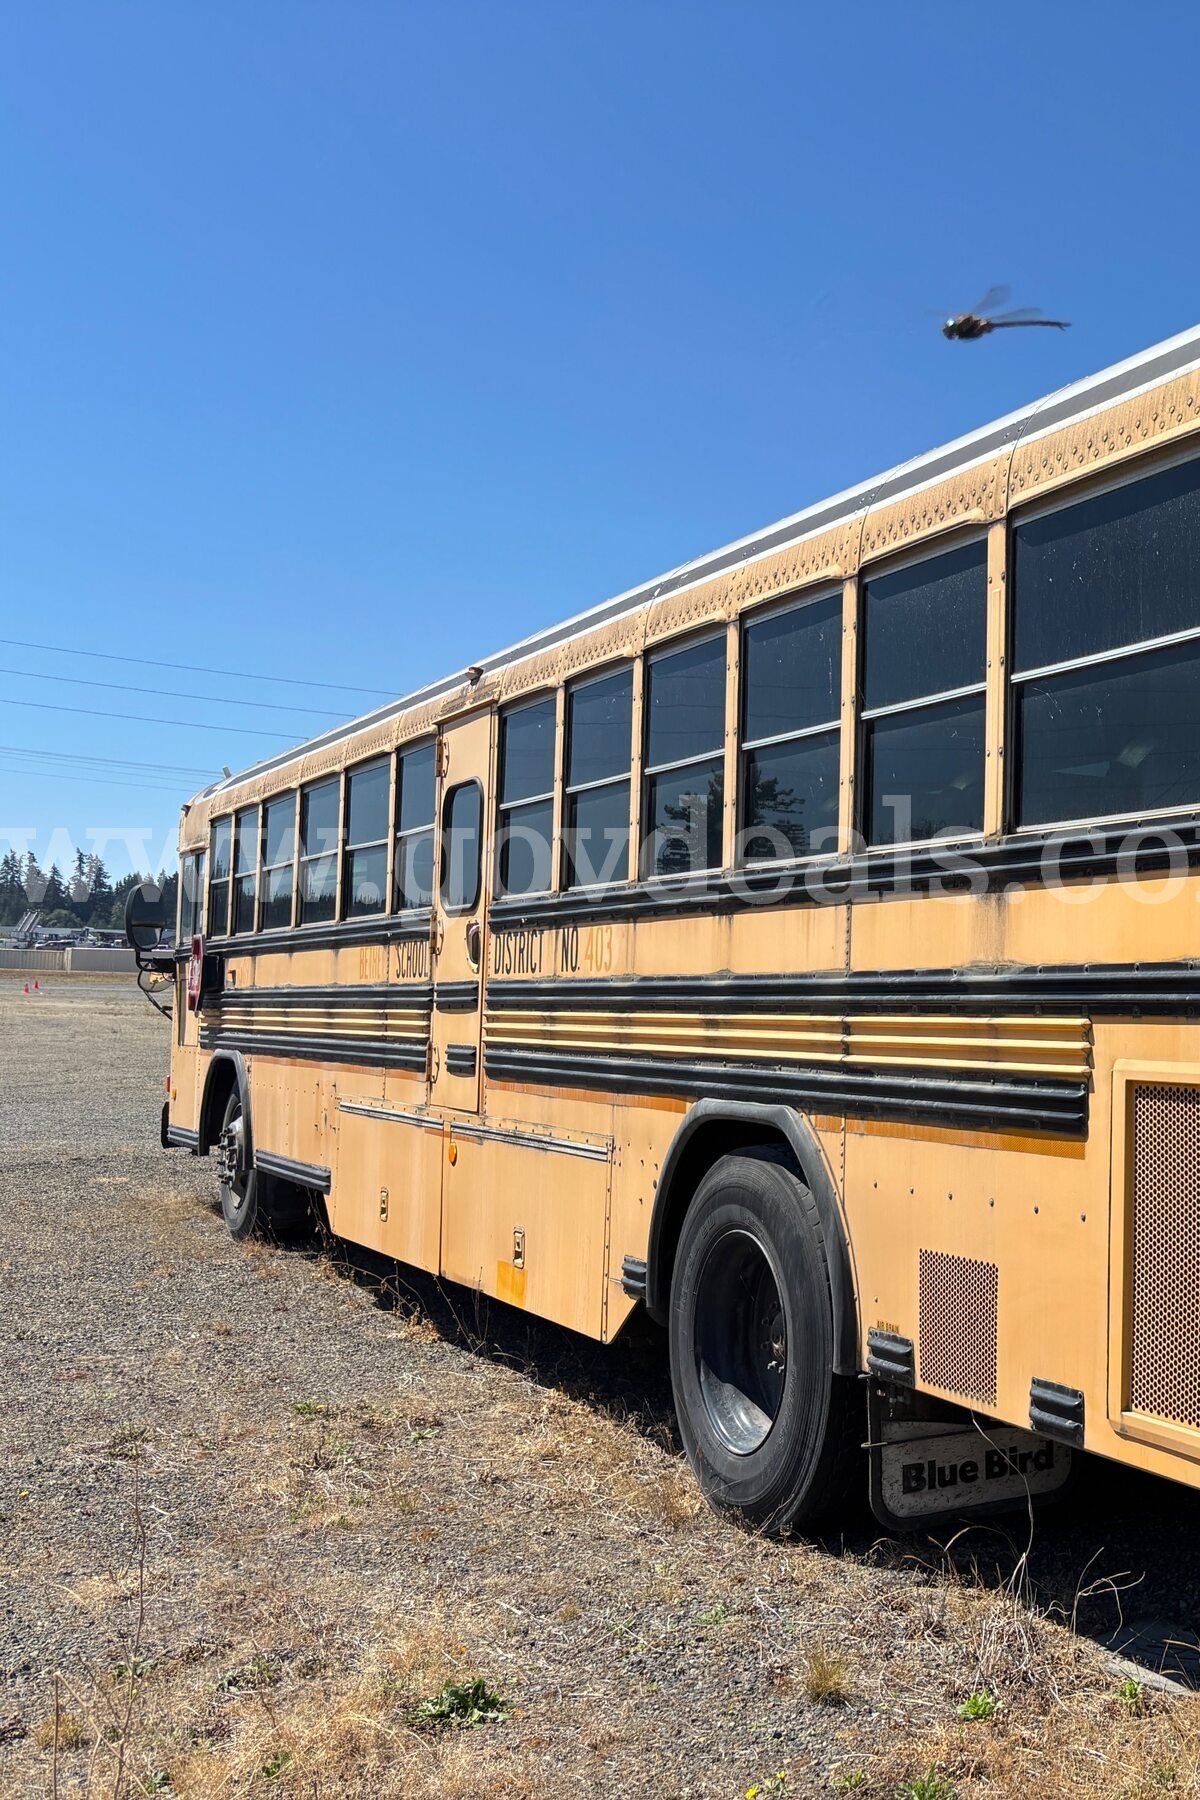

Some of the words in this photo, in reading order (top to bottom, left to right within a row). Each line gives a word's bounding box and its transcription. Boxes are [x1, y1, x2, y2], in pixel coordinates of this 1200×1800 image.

[396, 940, 428, 979] SCHOOL
[494, 930, 544, 976] DISTRICT
[561, 927, 580, 972] NO.
[584, 926, 612, 973] 403
[902, 1459, 979, 1494] Blue
[985, 1439, 1054, 1480] Bird
